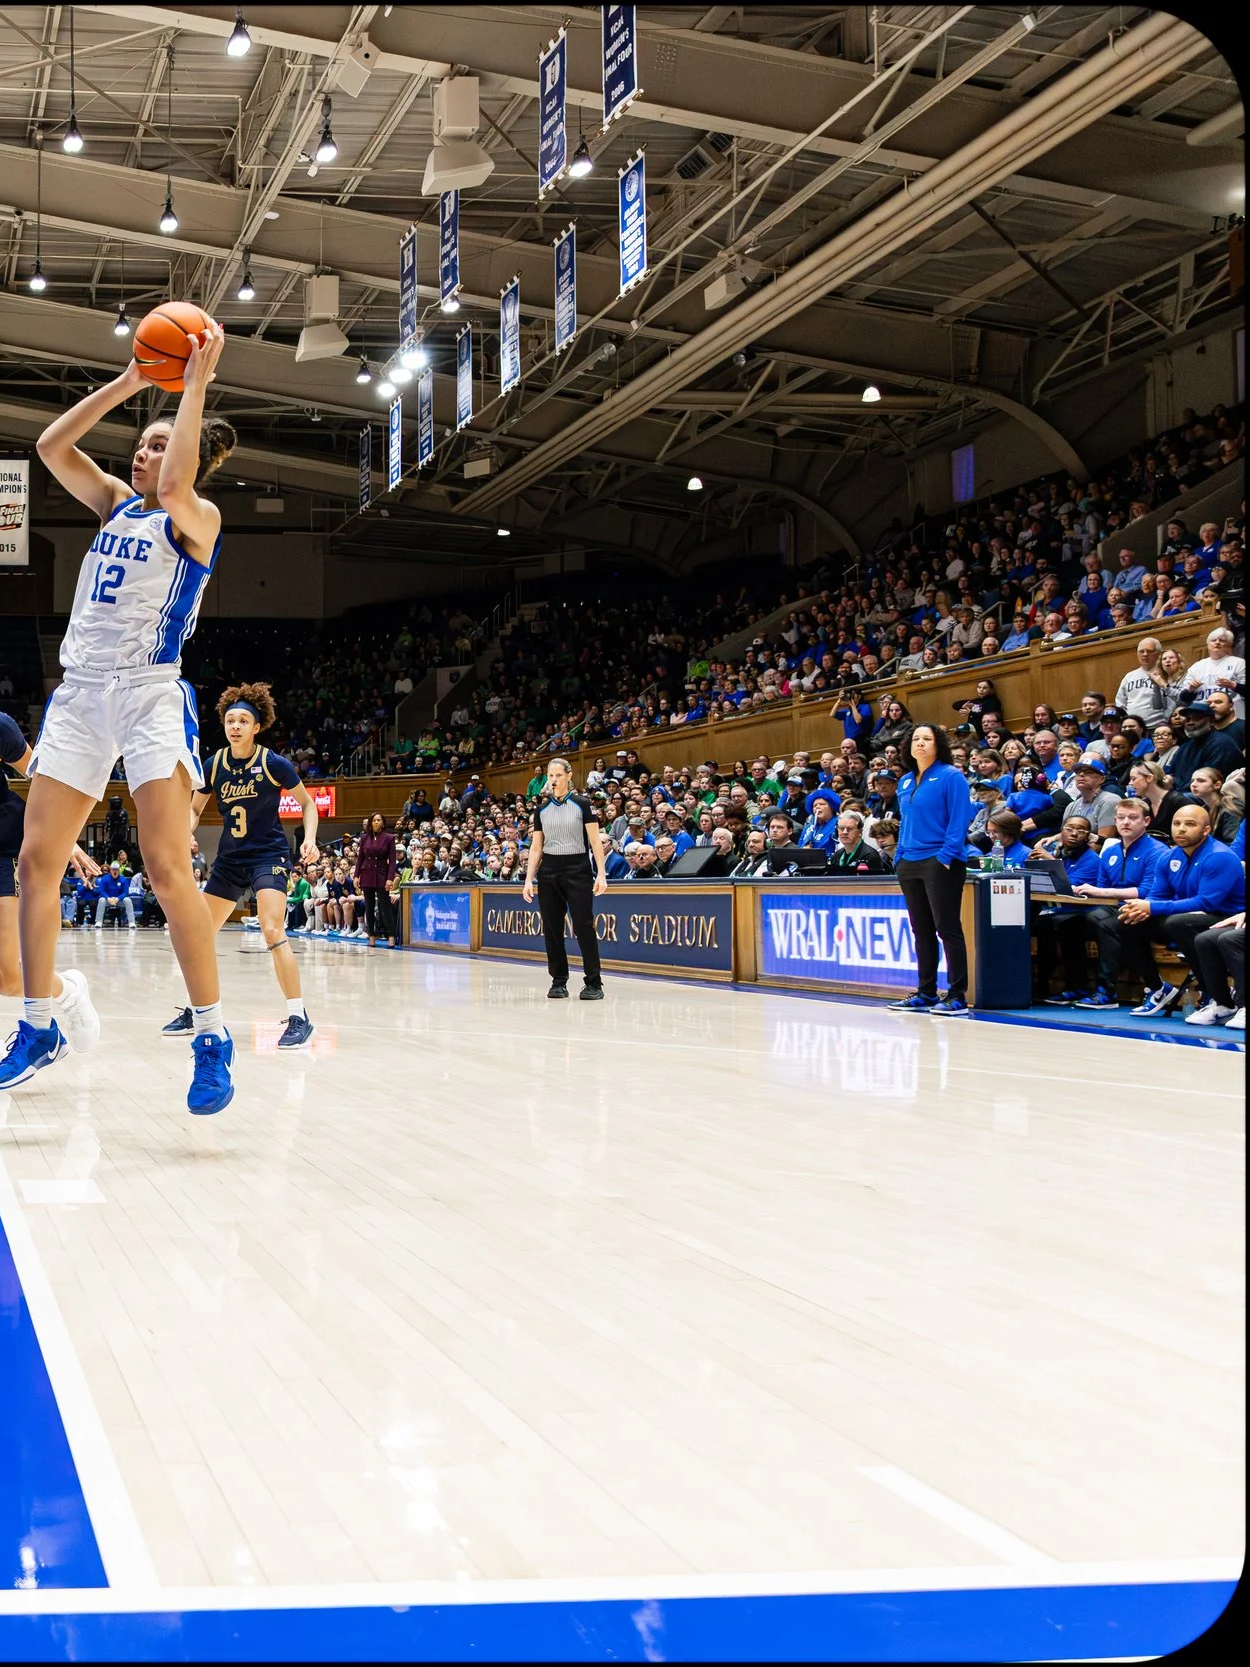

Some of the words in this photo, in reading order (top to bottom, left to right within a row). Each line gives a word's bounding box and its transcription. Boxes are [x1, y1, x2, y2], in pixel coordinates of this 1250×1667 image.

[617, 43, 633, 66] FOUR
[0, 503, 25, 516] FINAL
[90, 560, 127, 605] 12
[220, 778, 260, 804] Irish
[230, 804, 249, 839] 3
[487, 908, 545, 937] CAMERO
[630, 913, 719, 949] STADIUM
[767, 908, 837, 962] WRAL
[846, 915, 918, 964] NEW
